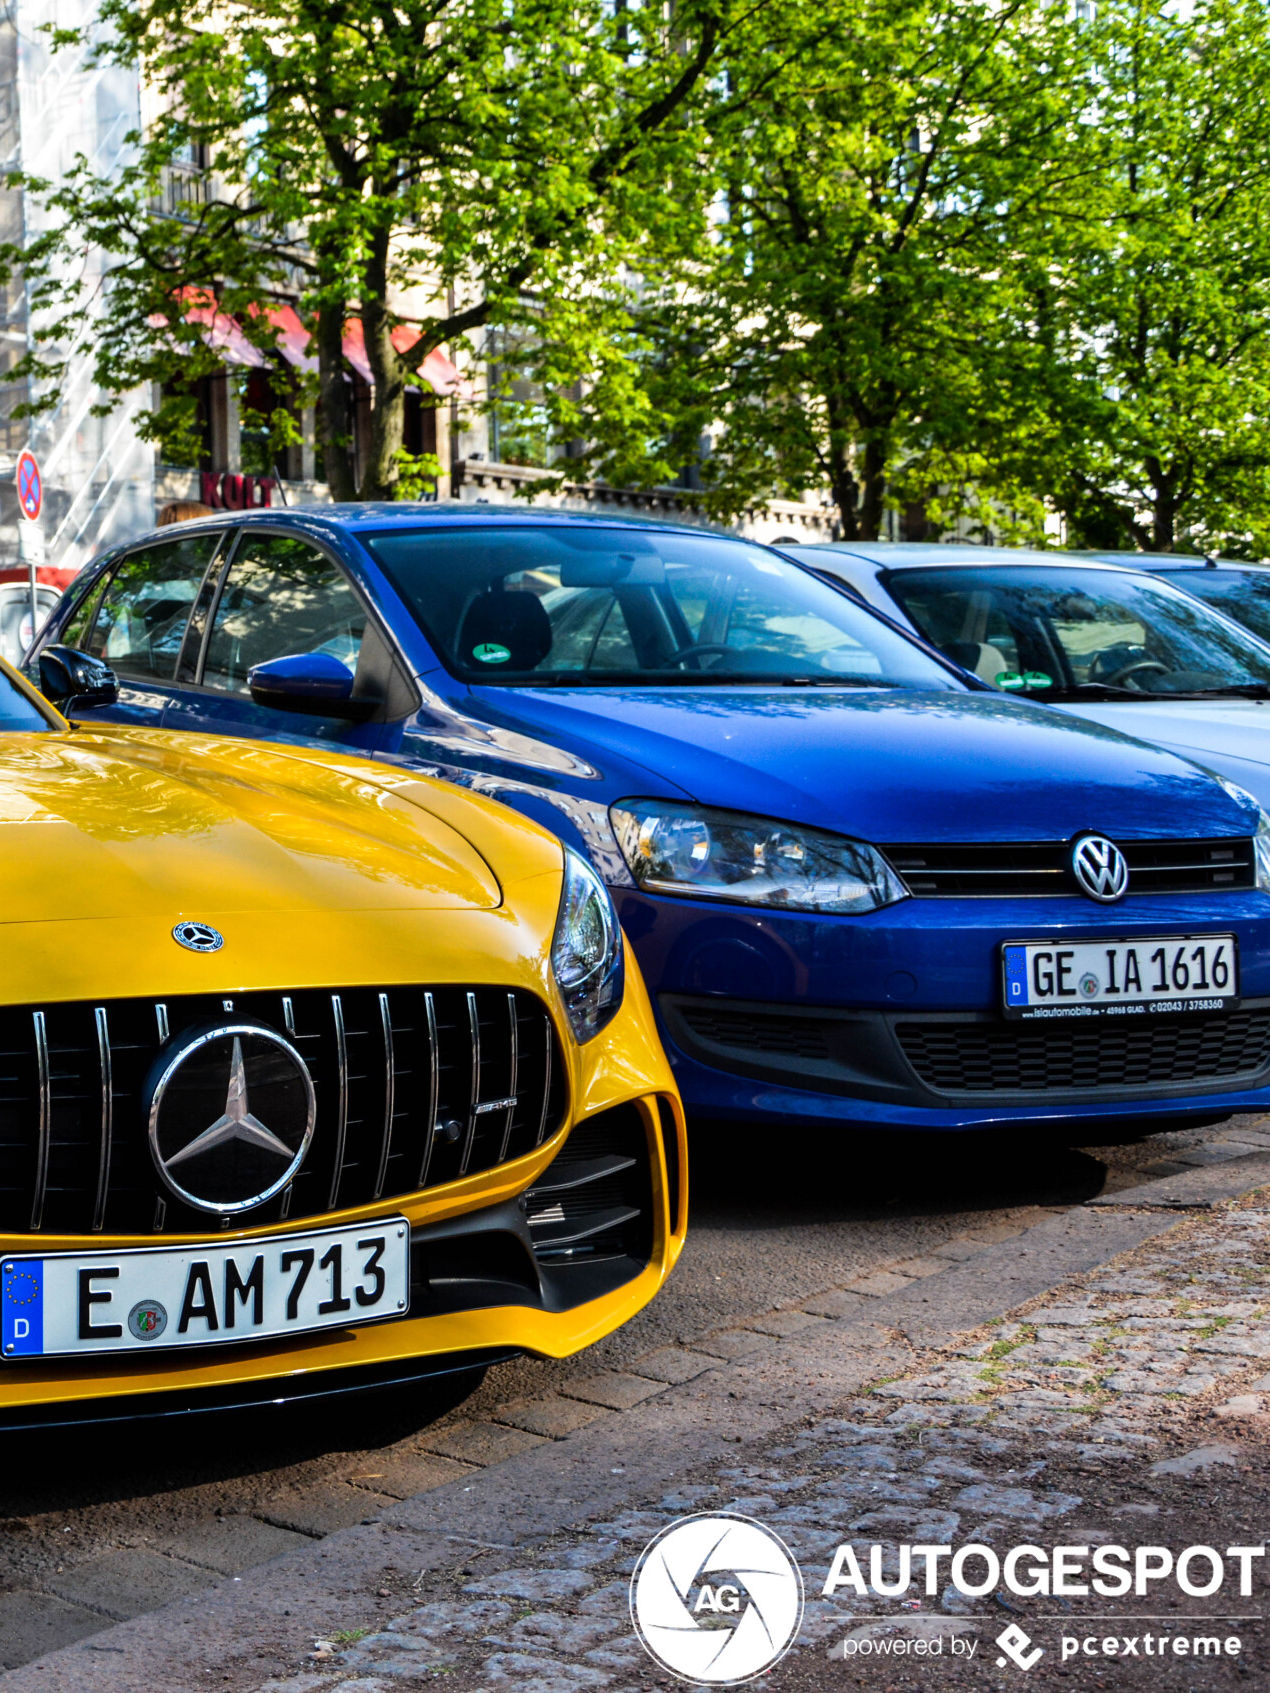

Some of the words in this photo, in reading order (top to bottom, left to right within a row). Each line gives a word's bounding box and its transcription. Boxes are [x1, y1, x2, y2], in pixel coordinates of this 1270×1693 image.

[202, 471, 277, 511] KULT
[1033, 951, 1077, 997] GE
[1104, 949, 1142, 994] IA
[1151, 945, 1229, 992] 1616
[1012, 982, 1021, 996] D
[1157, 1001, 1182, 1012] 02043
[78, 1266, 123, 1340] E
[177, 1254, 264, 1333] AM
[280, 1236, 386, 1321] 713
[14, 1318, 30, 1339] D
